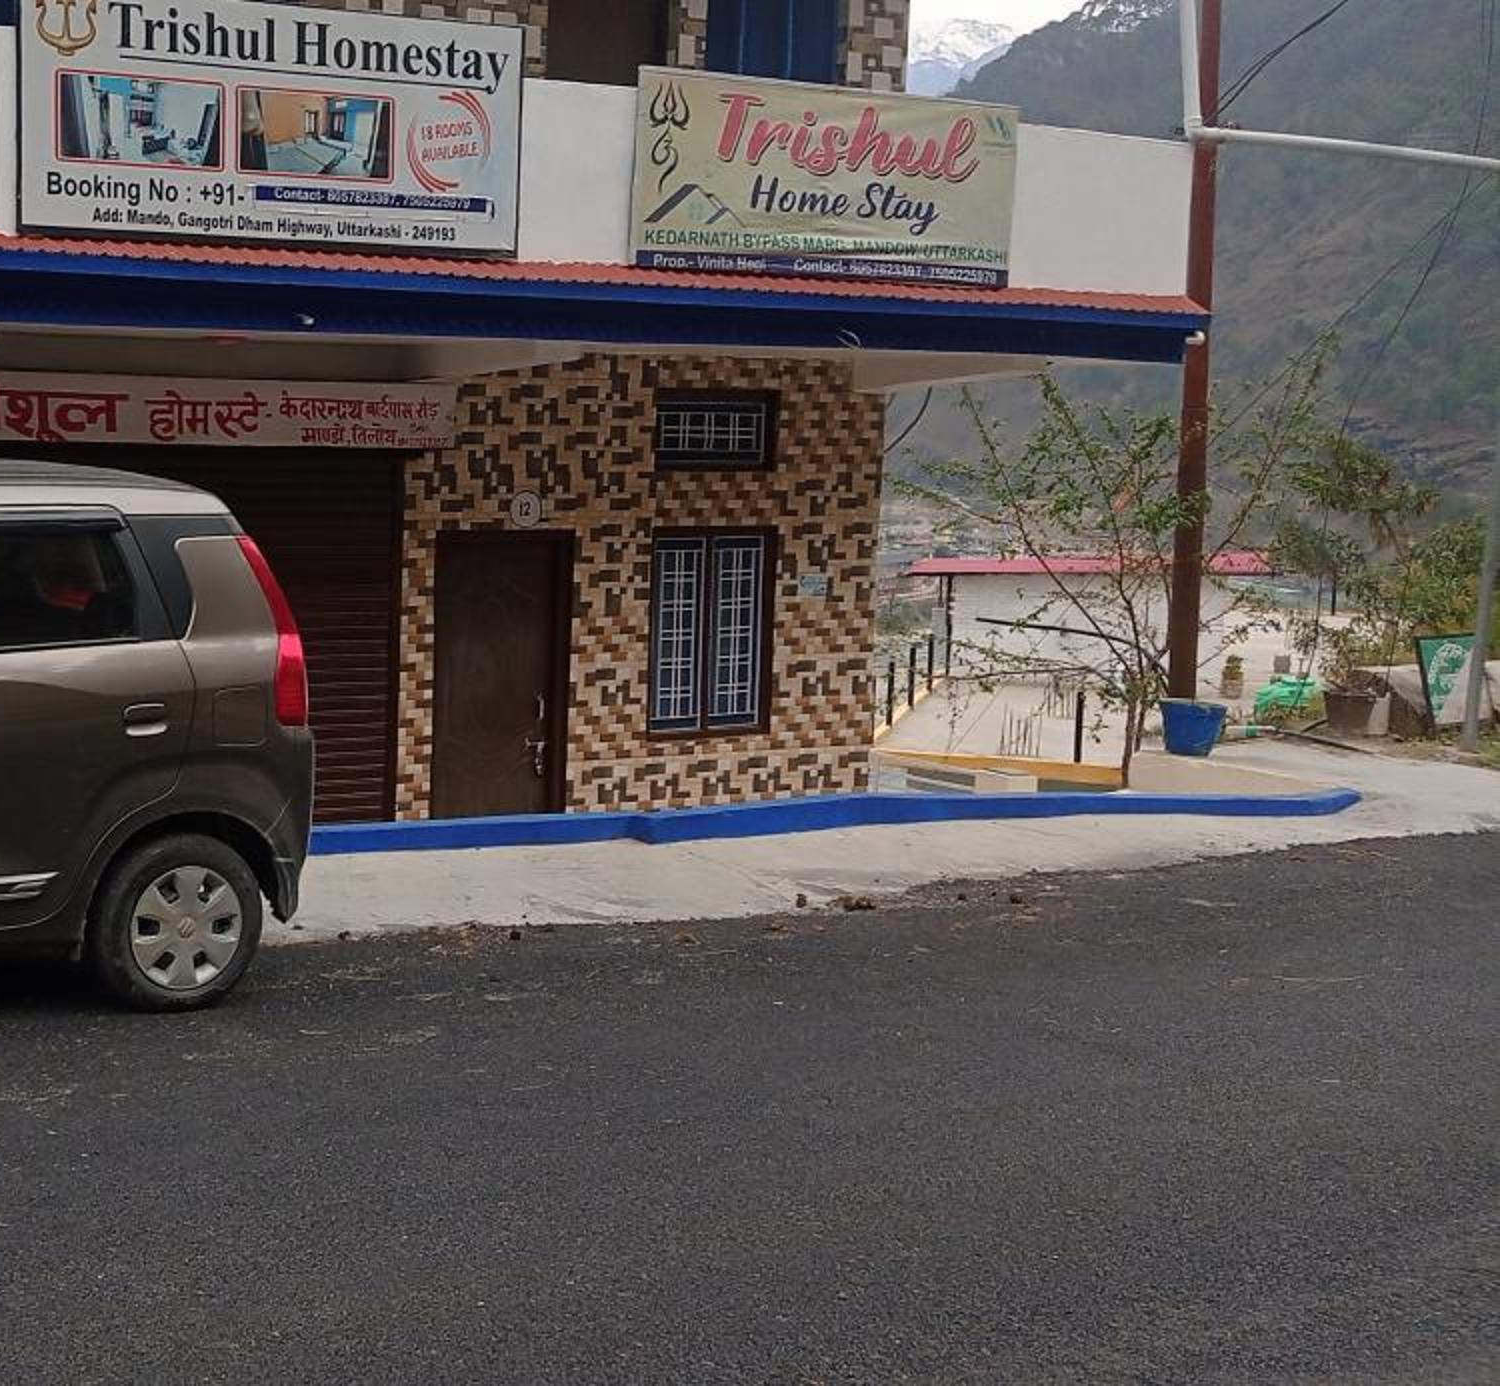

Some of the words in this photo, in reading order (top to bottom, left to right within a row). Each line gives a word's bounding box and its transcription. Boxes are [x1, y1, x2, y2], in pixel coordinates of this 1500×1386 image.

[108, 2, 277, 62] Trishul
[292, 20, 510, 94] Homestay
[715, 92, 981, 183] Trishul
[46, 171, 141, 206] Booking
[750, 173, 850, 218] Home
[857, 182, 940, 236] Stay
[92, 207, 123, 223] Add:
[127, 209, 175, 227] Mando,
[178, 211, 233, 233] Gangotri
[237, 215, 273, 232] Dham
[277, 217, 333, 238] Highway,
[337, 219, 401, 239] Uttarkashi
[412, 225, 456, 242] 249193
[643, 229, 739, 249] KEDARNATH
[742, 232, 800, 250] BYPASS
[697, 255, 733, 269] Vinita
[519, 501, 531, 517] 12
